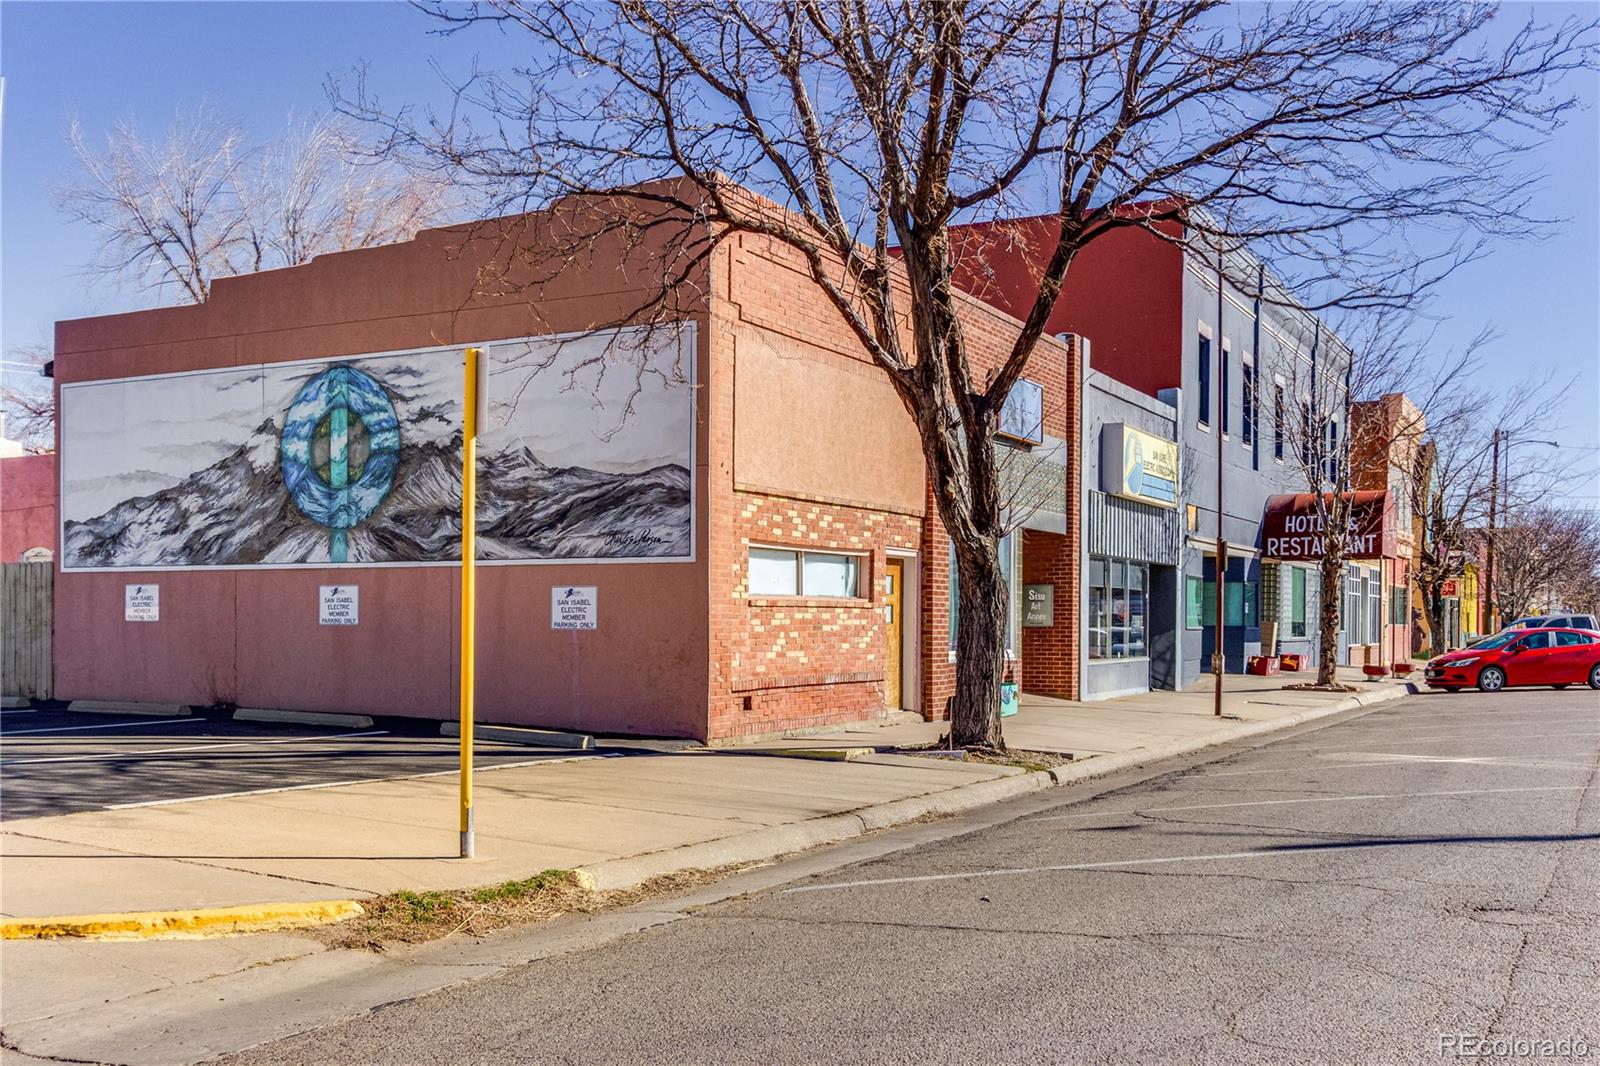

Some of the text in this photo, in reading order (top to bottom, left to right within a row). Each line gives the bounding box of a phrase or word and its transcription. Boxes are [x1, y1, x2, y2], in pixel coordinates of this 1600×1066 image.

[1285, 514, 1334, 533] HOTE
[1267, 534, 1377, 555] RESTAUANT
[1028, 589, 1046, 600] Sisu
[1030, 601, 1042, 610] Art
[1026, 611, 1047, 620] Annex
